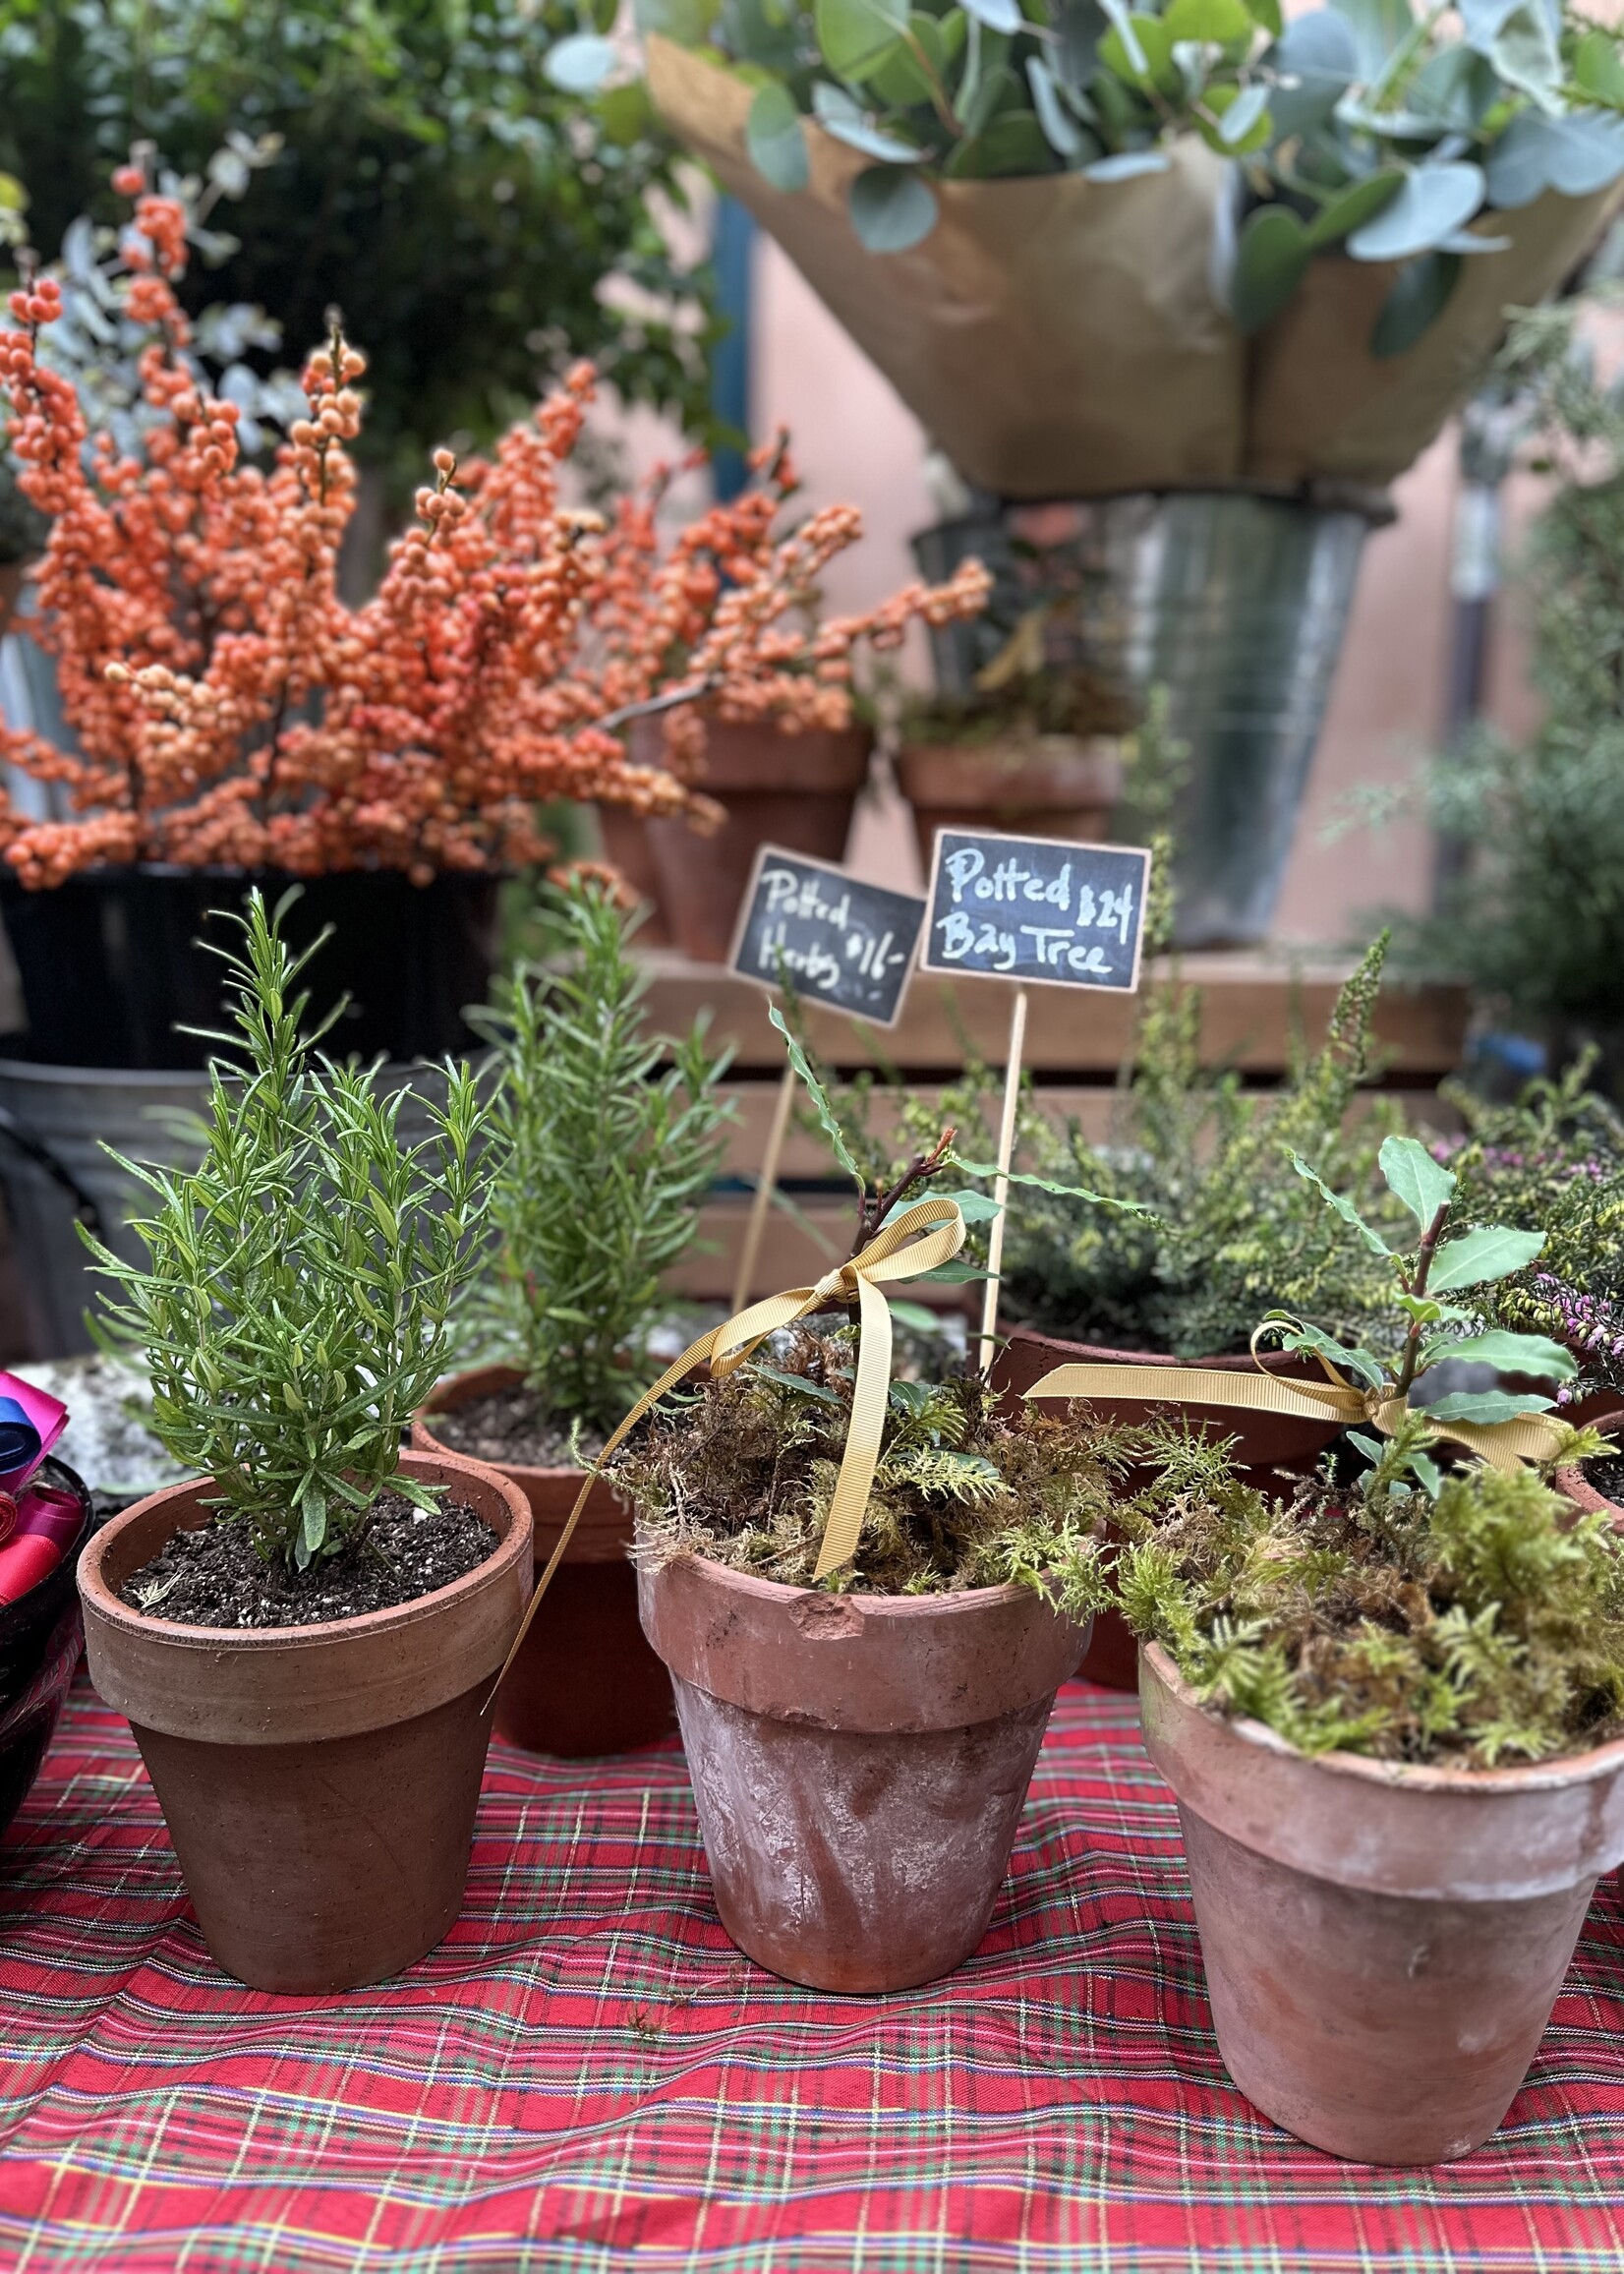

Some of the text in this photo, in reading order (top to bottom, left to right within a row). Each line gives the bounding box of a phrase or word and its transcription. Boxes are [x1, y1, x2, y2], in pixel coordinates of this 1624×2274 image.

[759, 869, 851, 931] Potted
[945, 847, 1132, 945] Potted $24
[936, 910, 1113, 973] Bay Tree
